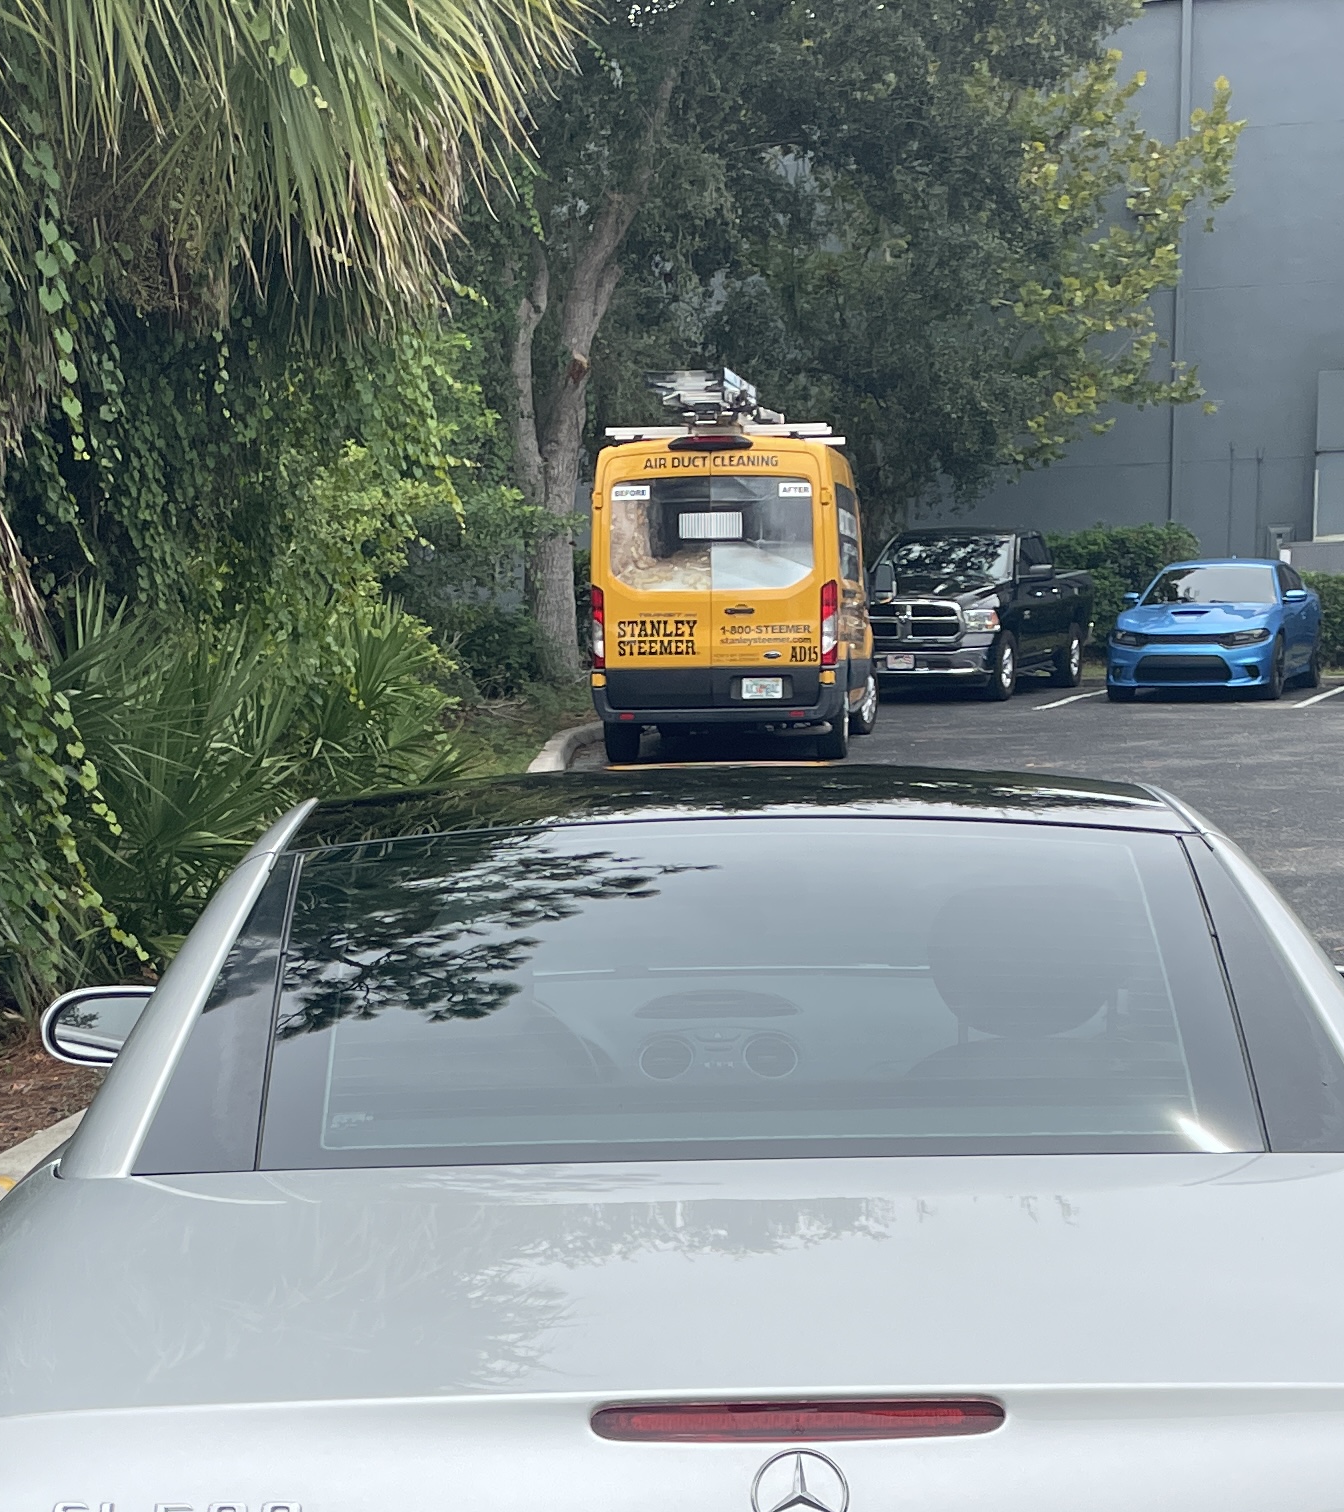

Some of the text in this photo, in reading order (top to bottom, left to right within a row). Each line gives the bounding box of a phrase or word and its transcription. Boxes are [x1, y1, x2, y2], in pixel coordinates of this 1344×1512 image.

[643, 454, 779, 470] AIR DUCT CLEANING
[614, 489, 647, 497] BEFORE
[782, 486, 810, 494] AFTER
[617, 619, 697, 638] STANLEY
[719, 624, 812, 635] 1-800-STEEMER
[719, 636, 812, 646] stanleysteemer.com
[617, 639, 697, 657] STEEMER
[789, 645, 819, 662] AD15
